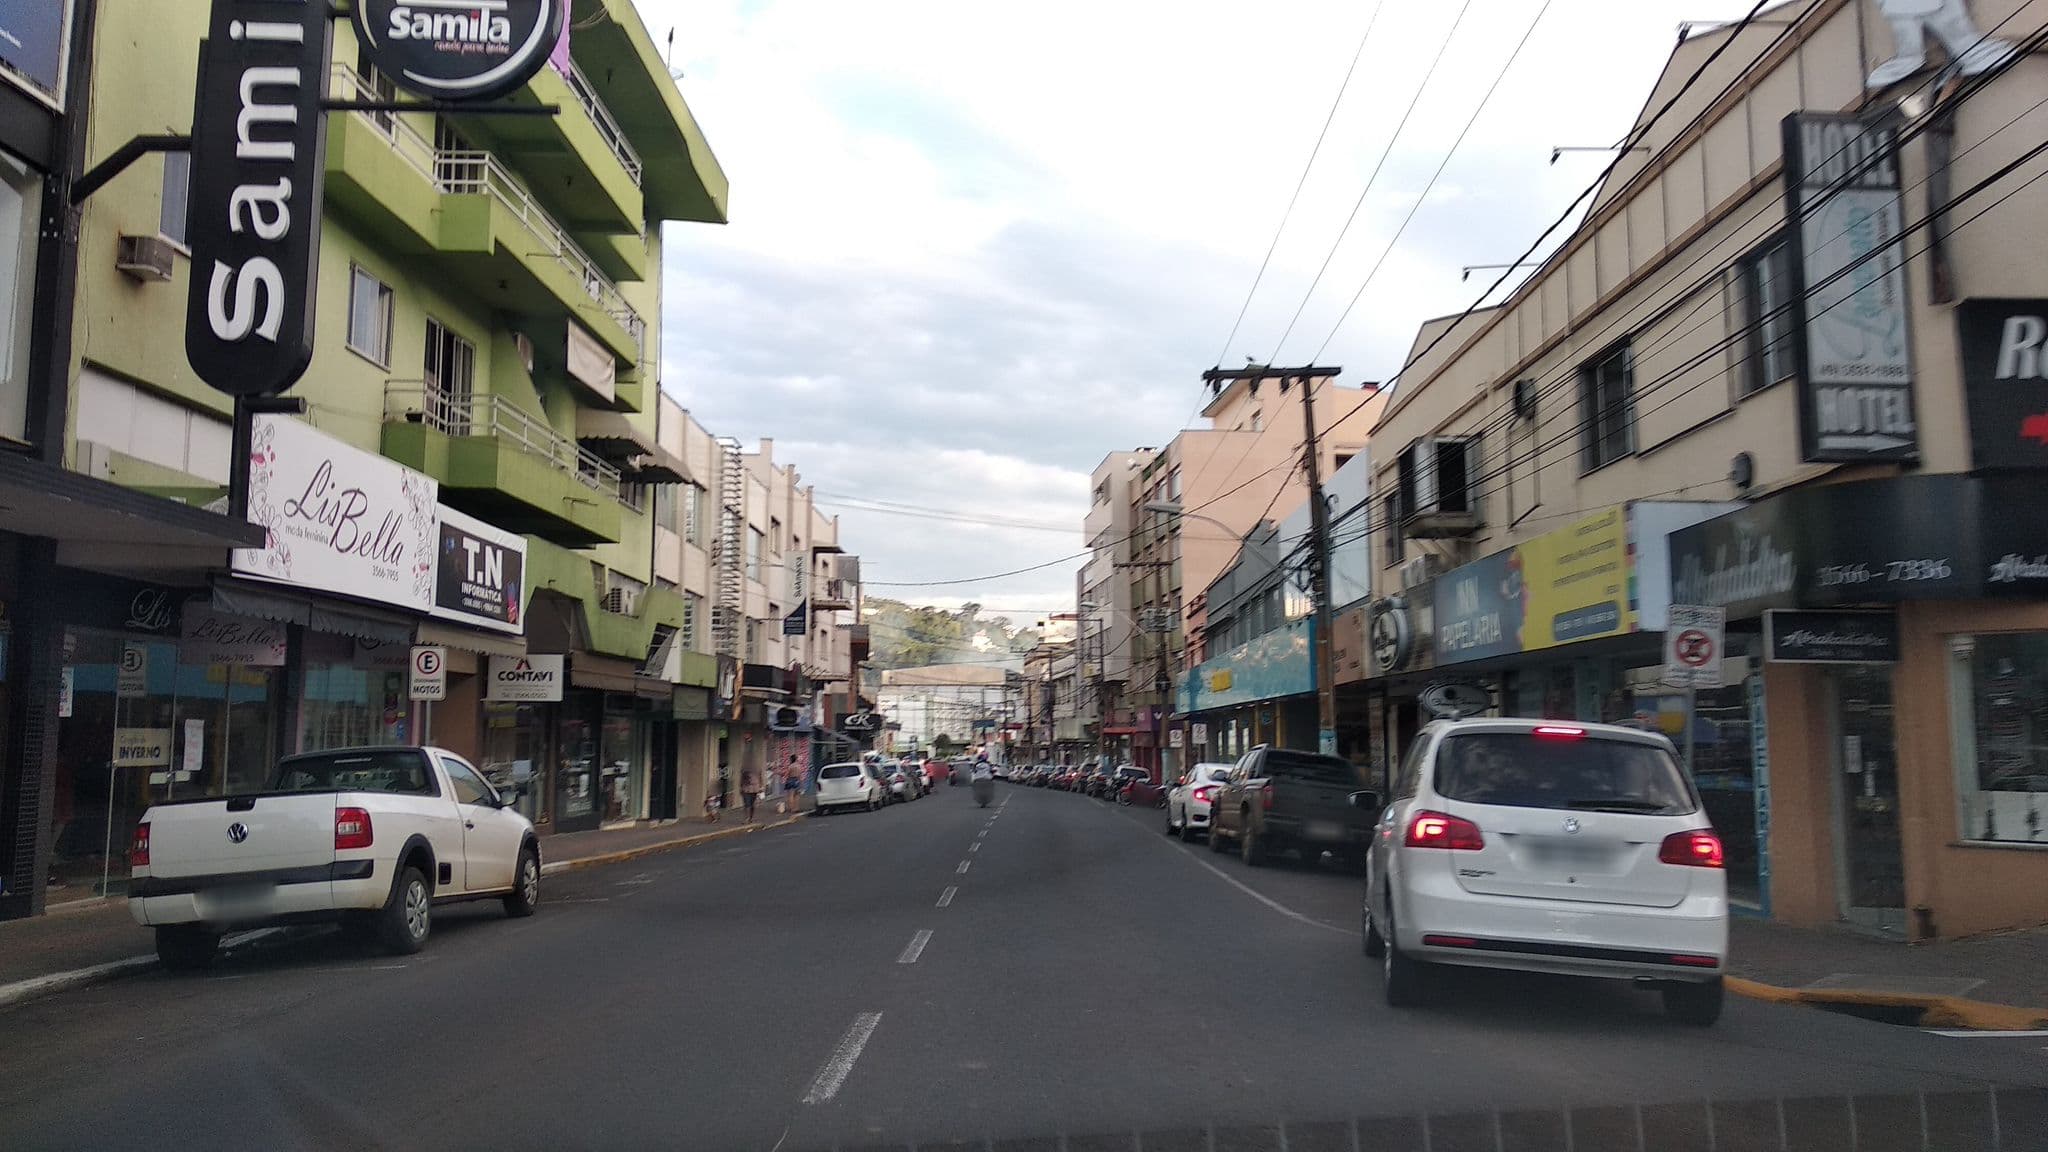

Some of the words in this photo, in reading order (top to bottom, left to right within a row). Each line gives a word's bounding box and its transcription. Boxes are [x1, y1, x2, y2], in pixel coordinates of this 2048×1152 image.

[388, 6, 511, 43] Samila
[207, 0, 304, 343] Sami
[1801, 121, 1898, 187] HOTEL
[1995, 315, 2048, 379] R
[1815, 386, 1918, 435] HOTEL
[304, 527, 329, 545] feminina
[1440, 611, 1502, 650] PAPELARIA
[424, 654, 433, 670] E
[497, 671, 553, 682] CONTAVI
[412, 684, 441, 695] MOTOS
